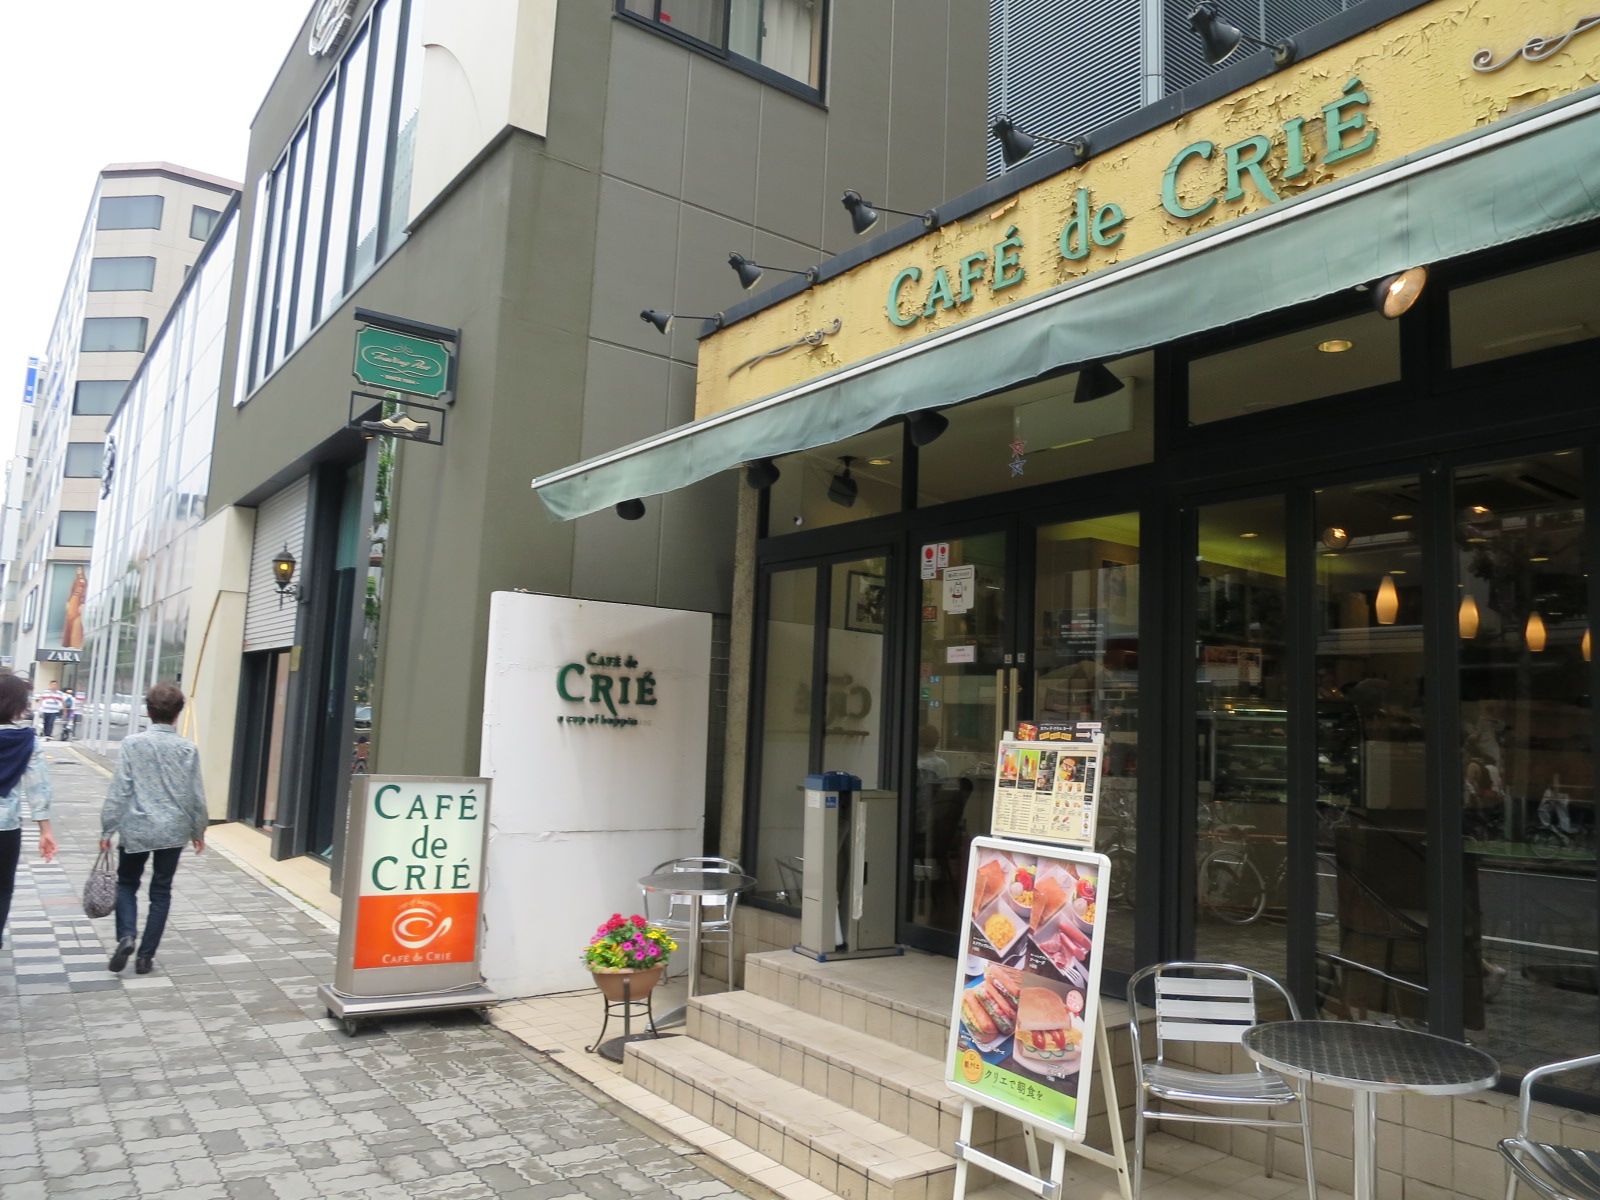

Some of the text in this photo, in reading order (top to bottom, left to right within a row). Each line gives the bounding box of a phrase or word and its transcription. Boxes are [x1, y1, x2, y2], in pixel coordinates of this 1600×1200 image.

[885, 77, 1378, 328] CAFÉ de CRIÉ
[47, 651, 81, 662] ZARA
[557, 663, 658, 717] CRIÉ
[374, 784, 478, 820] CAFÉ
[411, 824, 448, 859] de
[371, 856, 471, 891] CRIÉ
